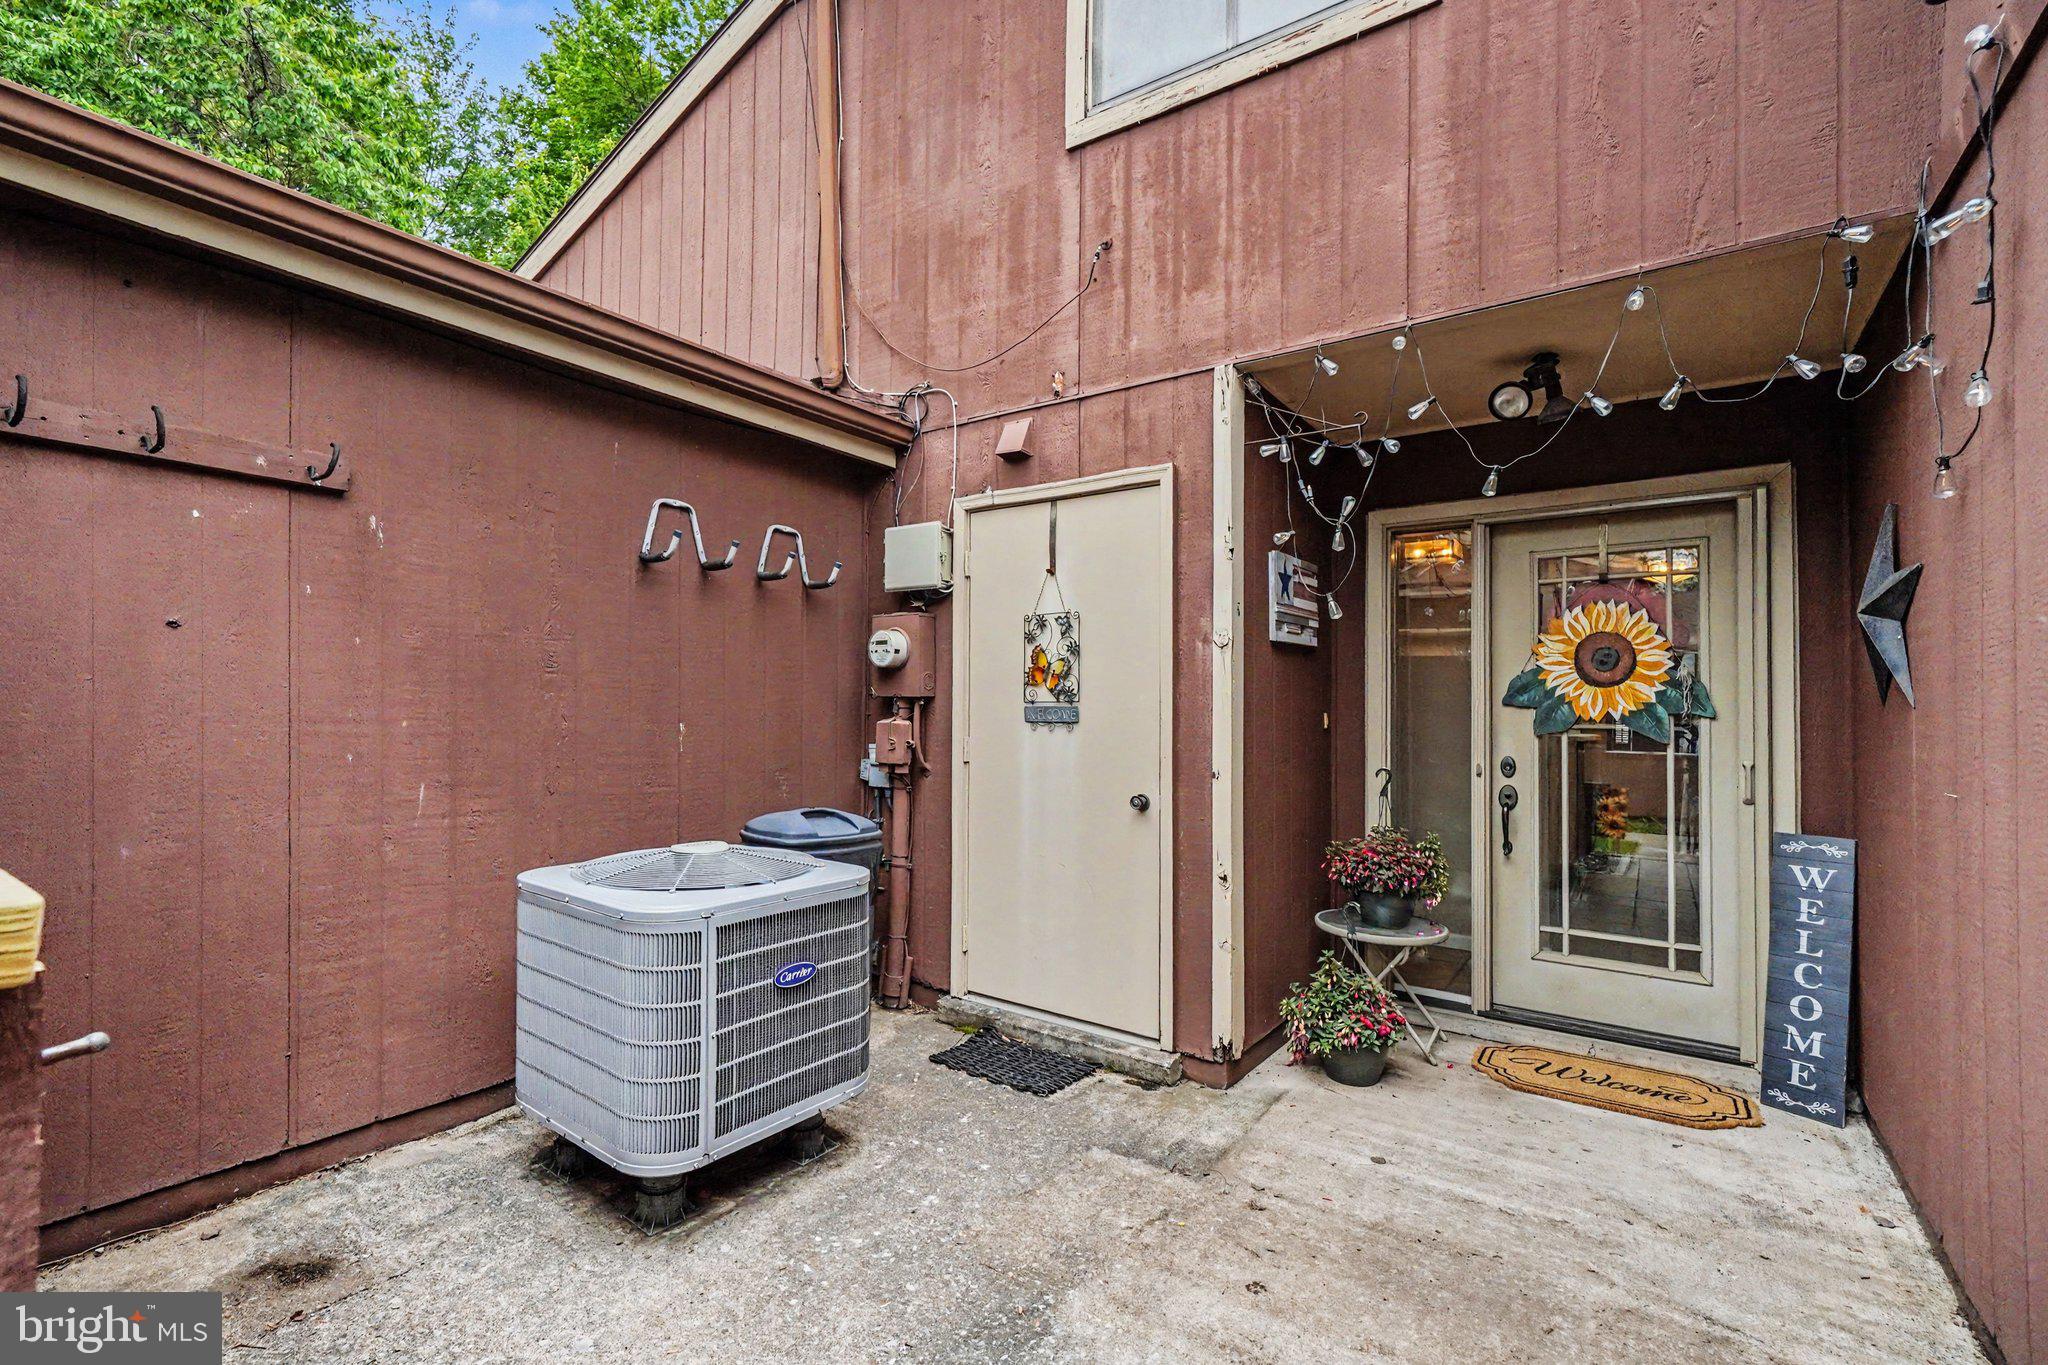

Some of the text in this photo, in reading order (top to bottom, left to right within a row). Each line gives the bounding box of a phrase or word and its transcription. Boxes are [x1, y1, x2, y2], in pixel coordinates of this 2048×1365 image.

[780, 967, 812, 983] Carrier
[1783, 864, 1838, 1091] WELCOME
[1508, 1057, 1708, 1105] Welcome
